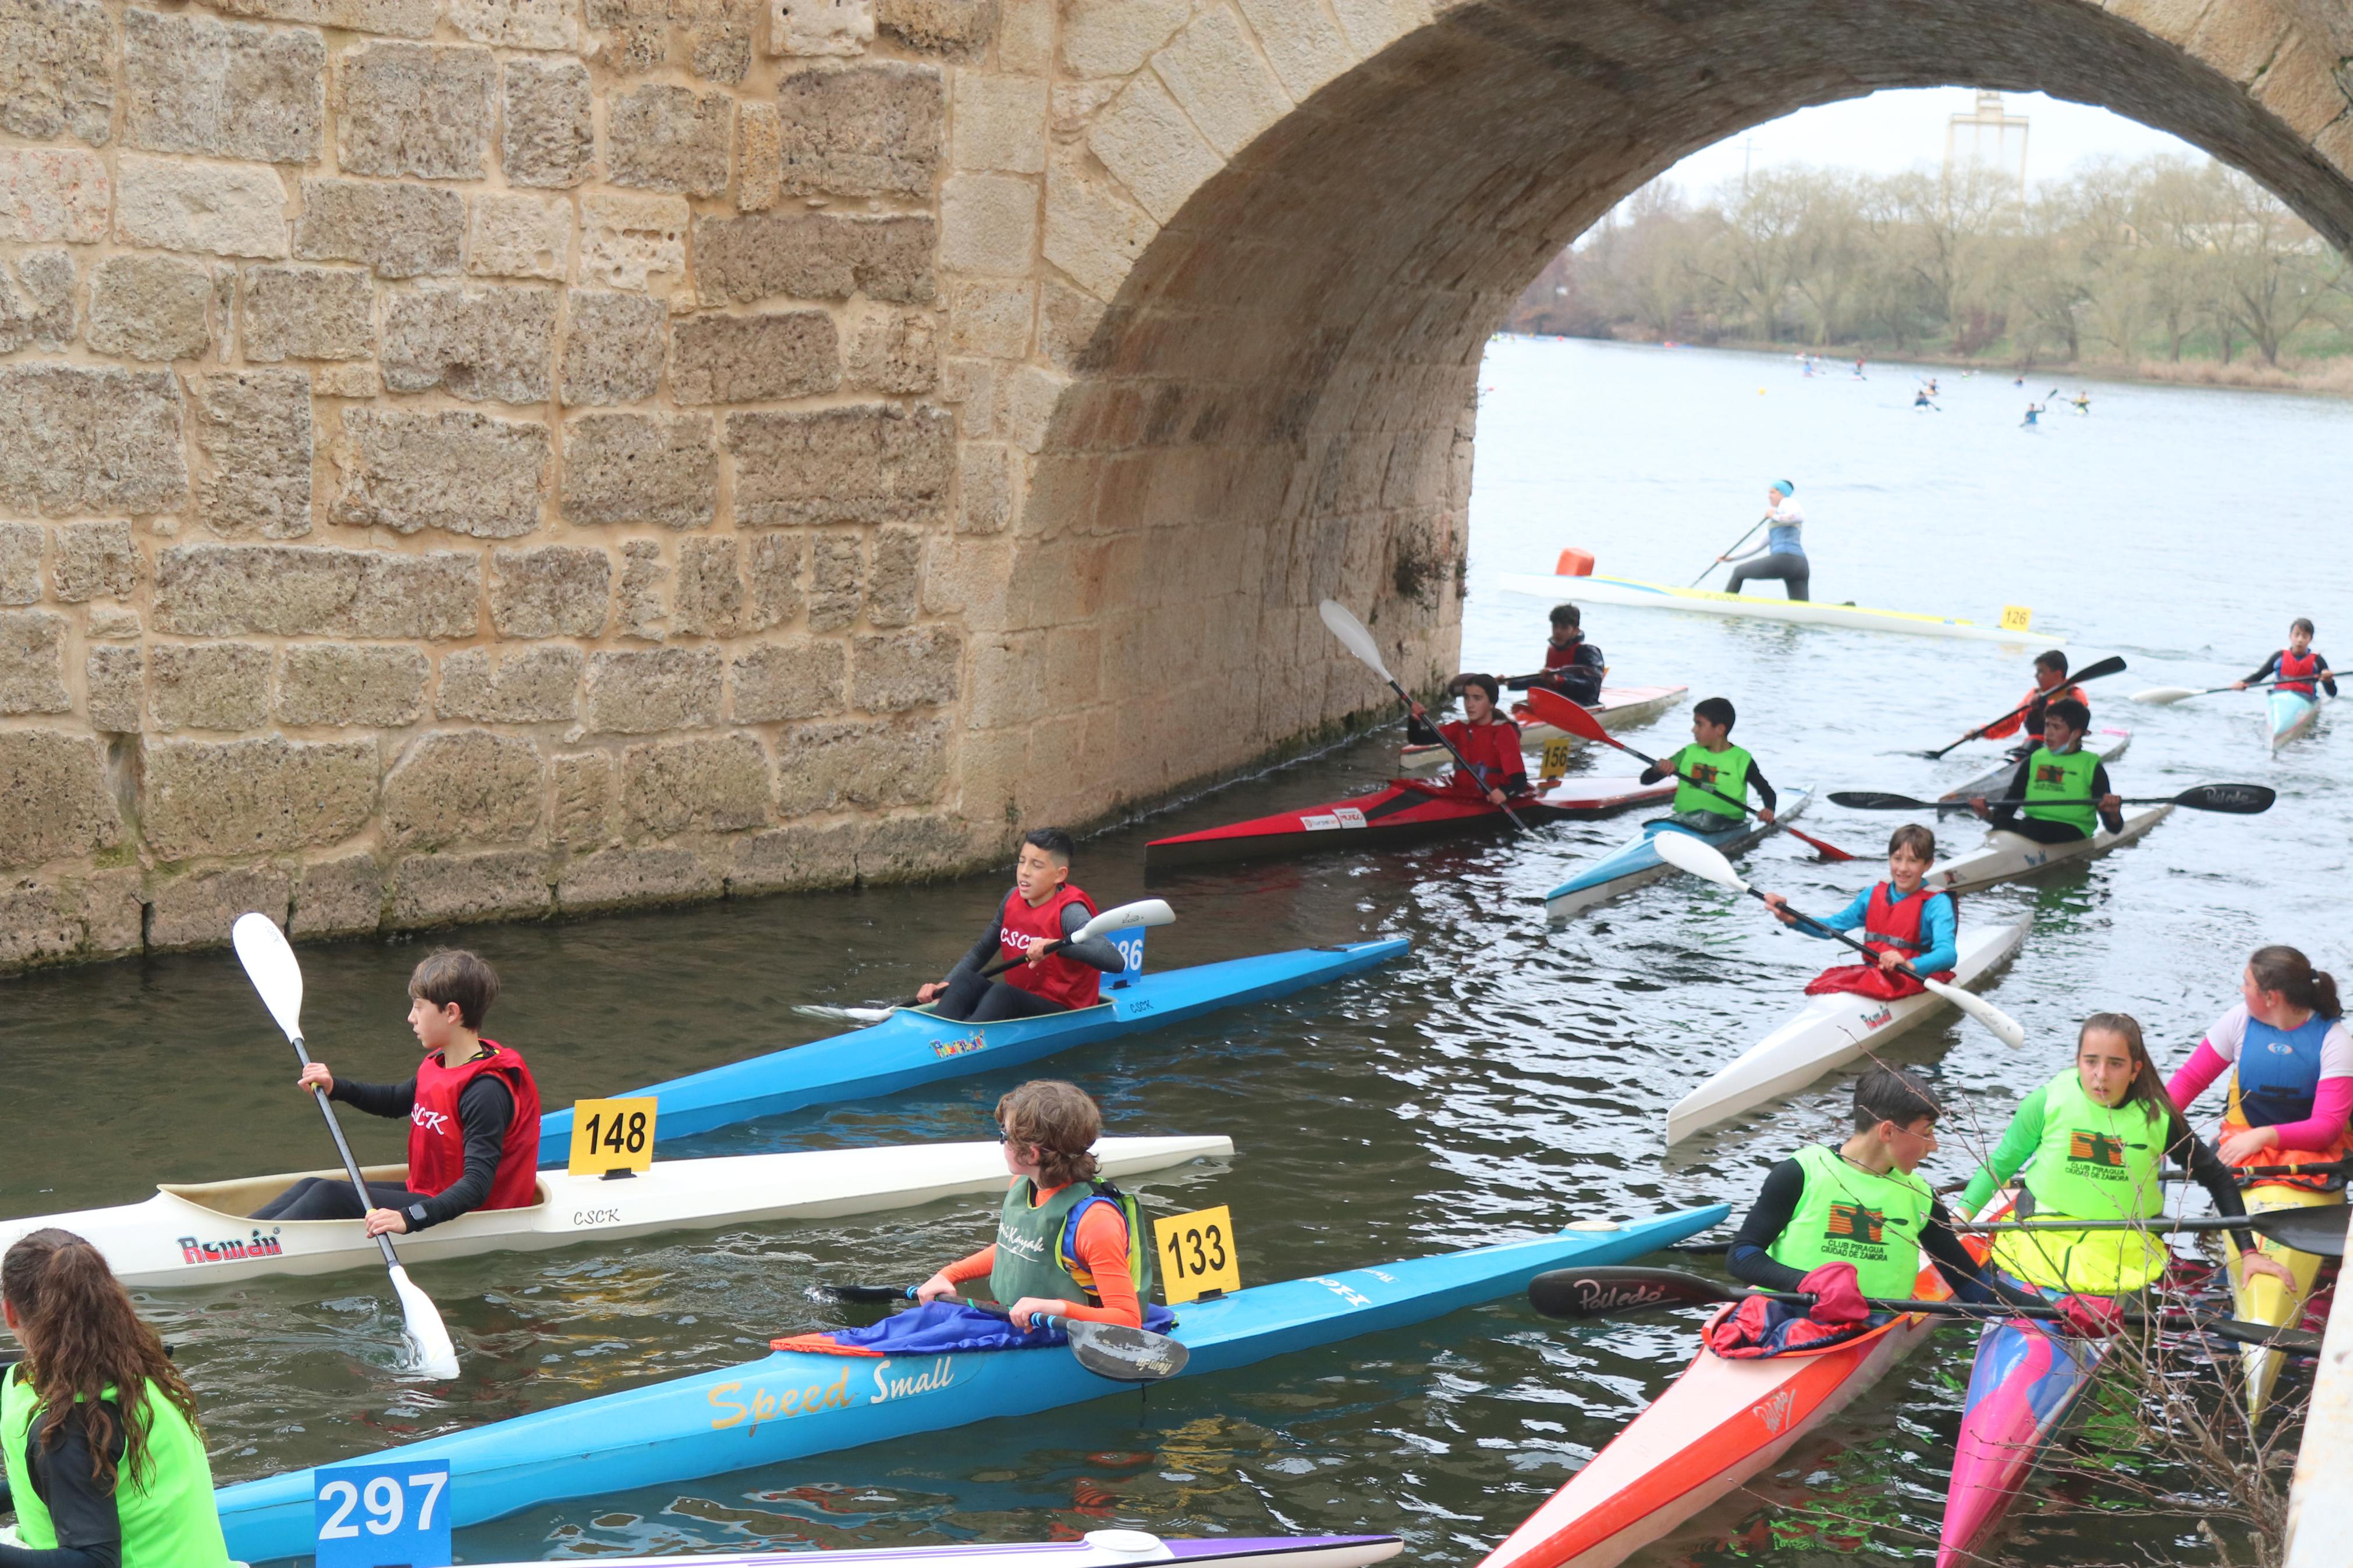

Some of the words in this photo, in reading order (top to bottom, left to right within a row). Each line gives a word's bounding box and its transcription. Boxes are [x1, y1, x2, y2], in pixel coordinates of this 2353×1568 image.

[2006, 610, 2027, 625] 126
[1545, 746, 1567, 767] 156
[1130, 999, 1154, 1014] CSCK
[585, 1112, 646, 1155] 148
[2065, 1167, 2089, 1178] CIUDAD
[2101, 1173, 2129, 1182] ZAMORA
[2071, 1162, 2091, 1171] CLUB
[2092, 1166, 2125, 1175] PIRAGUA
[573, 1208, 621, 1225] CSCK
[1168, 1225, 1226, 1279] 133
[1821, 1245, 1847, 1257] CIUDAD
[1848, 1250, 1858, 1258] DE
[1859, 1251, 1887, 1261] ZAMORA
[1828, 1240, 1849, 1249] CLUB
[1851, 1243, 1884, 1254] PIRAGUA
[870, 1356, 954, 1405] Small
[707, 1366, 856, 1438] Speed
[318, 1471, 448, 1540] 297
